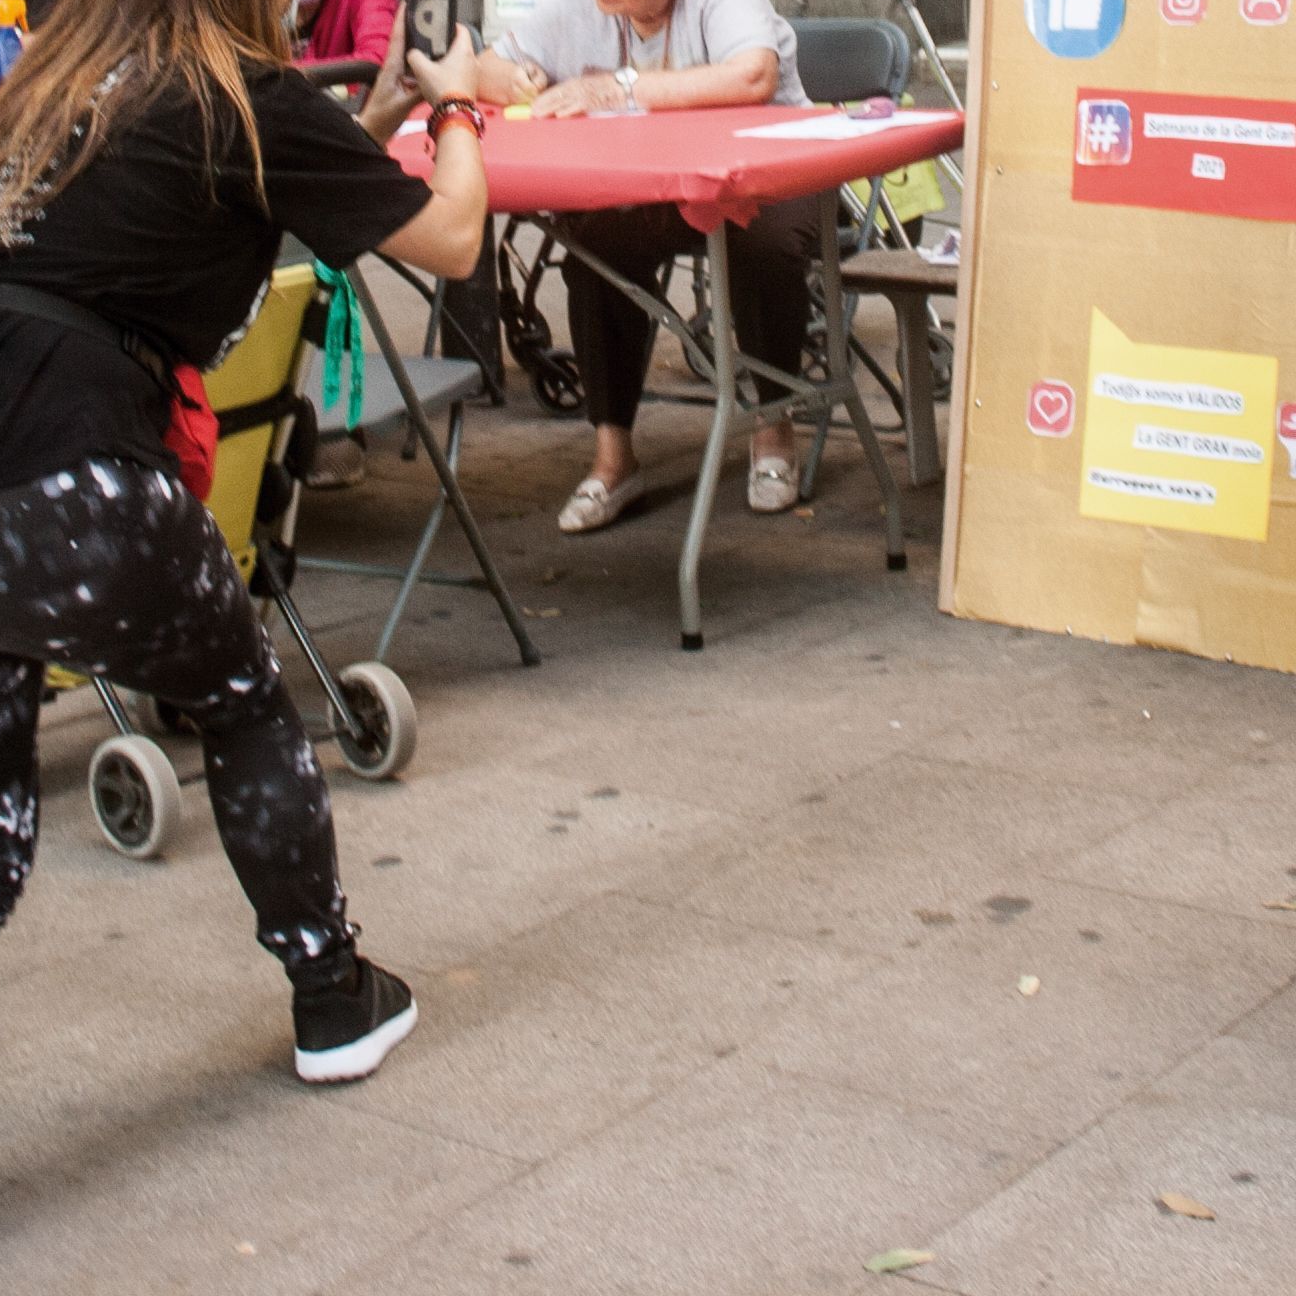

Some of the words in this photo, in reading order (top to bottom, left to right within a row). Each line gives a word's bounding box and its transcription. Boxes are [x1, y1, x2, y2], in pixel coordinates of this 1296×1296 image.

[1202, 122, 1217, 136] de
[1219, 123, 1231, 137] la
[1234, 124, 1263, 139] Gent
[1155, 430, 1189, 449] GENT
[1192, 436, 1229, 457] GRAN
